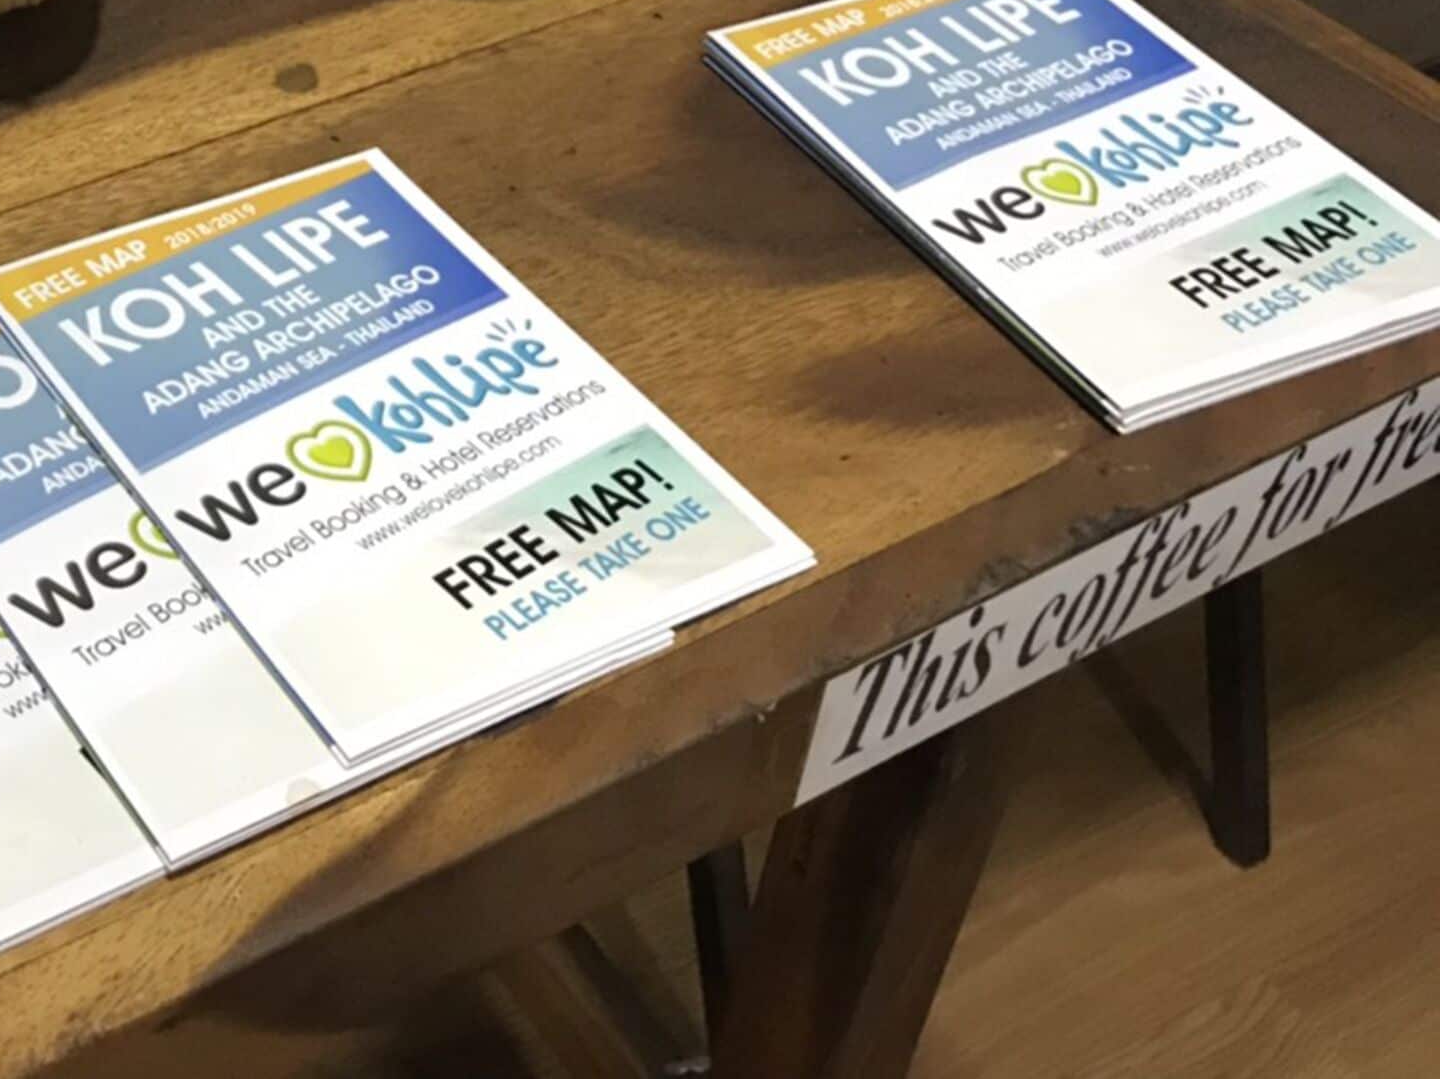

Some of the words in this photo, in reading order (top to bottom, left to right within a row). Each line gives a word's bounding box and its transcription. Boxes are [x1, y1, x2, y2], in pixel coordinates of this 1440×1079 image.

[753, 27, 816, 61] FREE
[812, 7, 868, 38] MAP
[796, 26, 961, 107] KOH
[926, 68, 983, 100] AND
[979, 51, 1029, 79] THE
[883, 99, 977, 146] ADANG
[976, 38, 1136, 111] ARCHIPELAGO
[936, 110, 1021, 152] ANDAMAN
[1018, 101, 1051, 122] SEA
[1057, 66, 1134, 107] THAILAND
[932, 185, 1047, 247] we
[1054, 96, 1255, 189] kohlipe
[995, 233, 1059, 275] Travel
[1057, 204, 1135, 247] Booking
[1126, 199, 1146, 218] &
[1144, 175, 1194, 212] Hotel
[1190, 133, 1304, 190] Reservations
[13, 266, 88, 310] FREE
[83, 238, 149, 279] MAP
[163, 202, 258, 251] 2018/2019
[57, 261, 245, 367] KOH
[230, 199, 391, 288] LIPE
[1168, 246, 1281, 310] FREE
[1260, 199, 1380, 265] MAP!
[1219, 283, 1313, 334] PLEASE
[1300, 256, 1366, 295] TAKE
[1357, 231, 1418, 267] ONE
[140, 348, 250, 416] ADANG
[258, 264, 442, 362] ARCHIPELAGO
[196, 361, 297, 420] ANDAMAN
[300, 346, 337, 373] SEA
[343, 298, 436, 349] THAILAND
[201, 309, 266, 350] AND
[263, 282, 322, 322] THE
[174, 462, 308, 544] we
[333, 336, 560, 454] kohlipe
[240, 527, 315, 579] Travel
[310, 480, 407, 541] Booking
[401, 471, 426, 492] &
[424, 442, 482, 480] Hotel
[478, 377, 607, 450] Reservations
[355, 433, 562, 552] www.welovekohlipe.com
[6, 540, 148, 629] we
[431, 524, 561, 610] FREE
[544, 458, 675, 544] MAP!
[483, 570, 588, 641] PLEASE
[577, 531, 651, 582] TAKE
[644, 495, 711, 542] ONE
[830, 605, 1007, 766] This
[1018, 500, 1239, 666] coffee
[1212, 444, 1353, 587] for
[1323, 387, 1440, 533] fre
[71, 613, 152, 668] Travel
